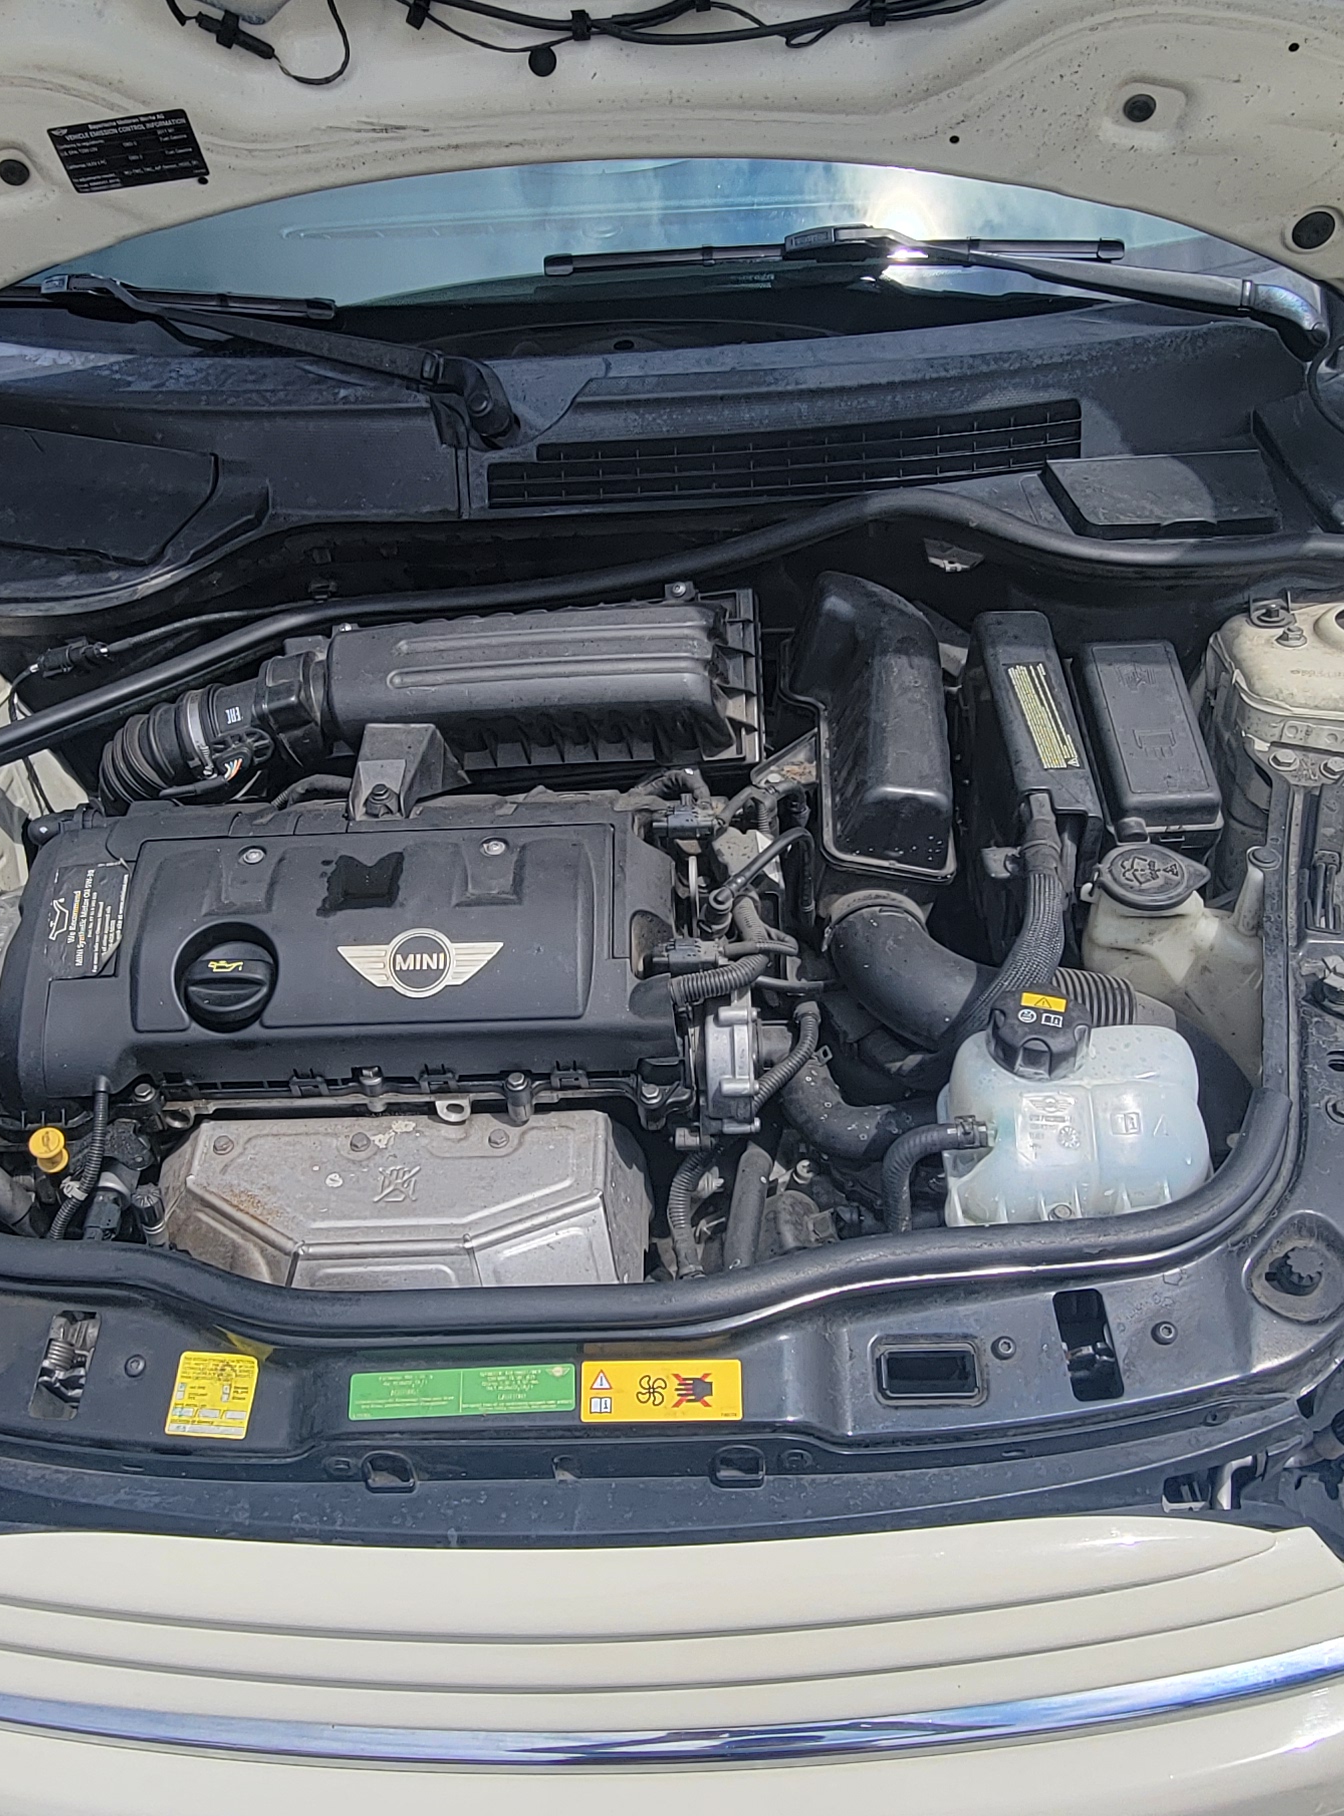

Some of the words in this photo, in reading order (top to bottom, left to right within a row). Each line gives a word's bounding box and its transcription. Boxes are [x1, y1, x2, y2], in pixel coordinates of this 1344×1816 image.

[65, 132, 89, 141] VEHICLE
[89, 127, 118, 138] EMISSION
[118, 123, 146, 133] CONTROL
[145, 118, 187, 130] INFORMATION
[83, 889, 91, 898] Oil
[79, 899, 89, 918] Motor
[77, 919, 87, 949] Synthetic
[75, 949, 84, 966] MINI
[396, 952, 445, 971] MINI
